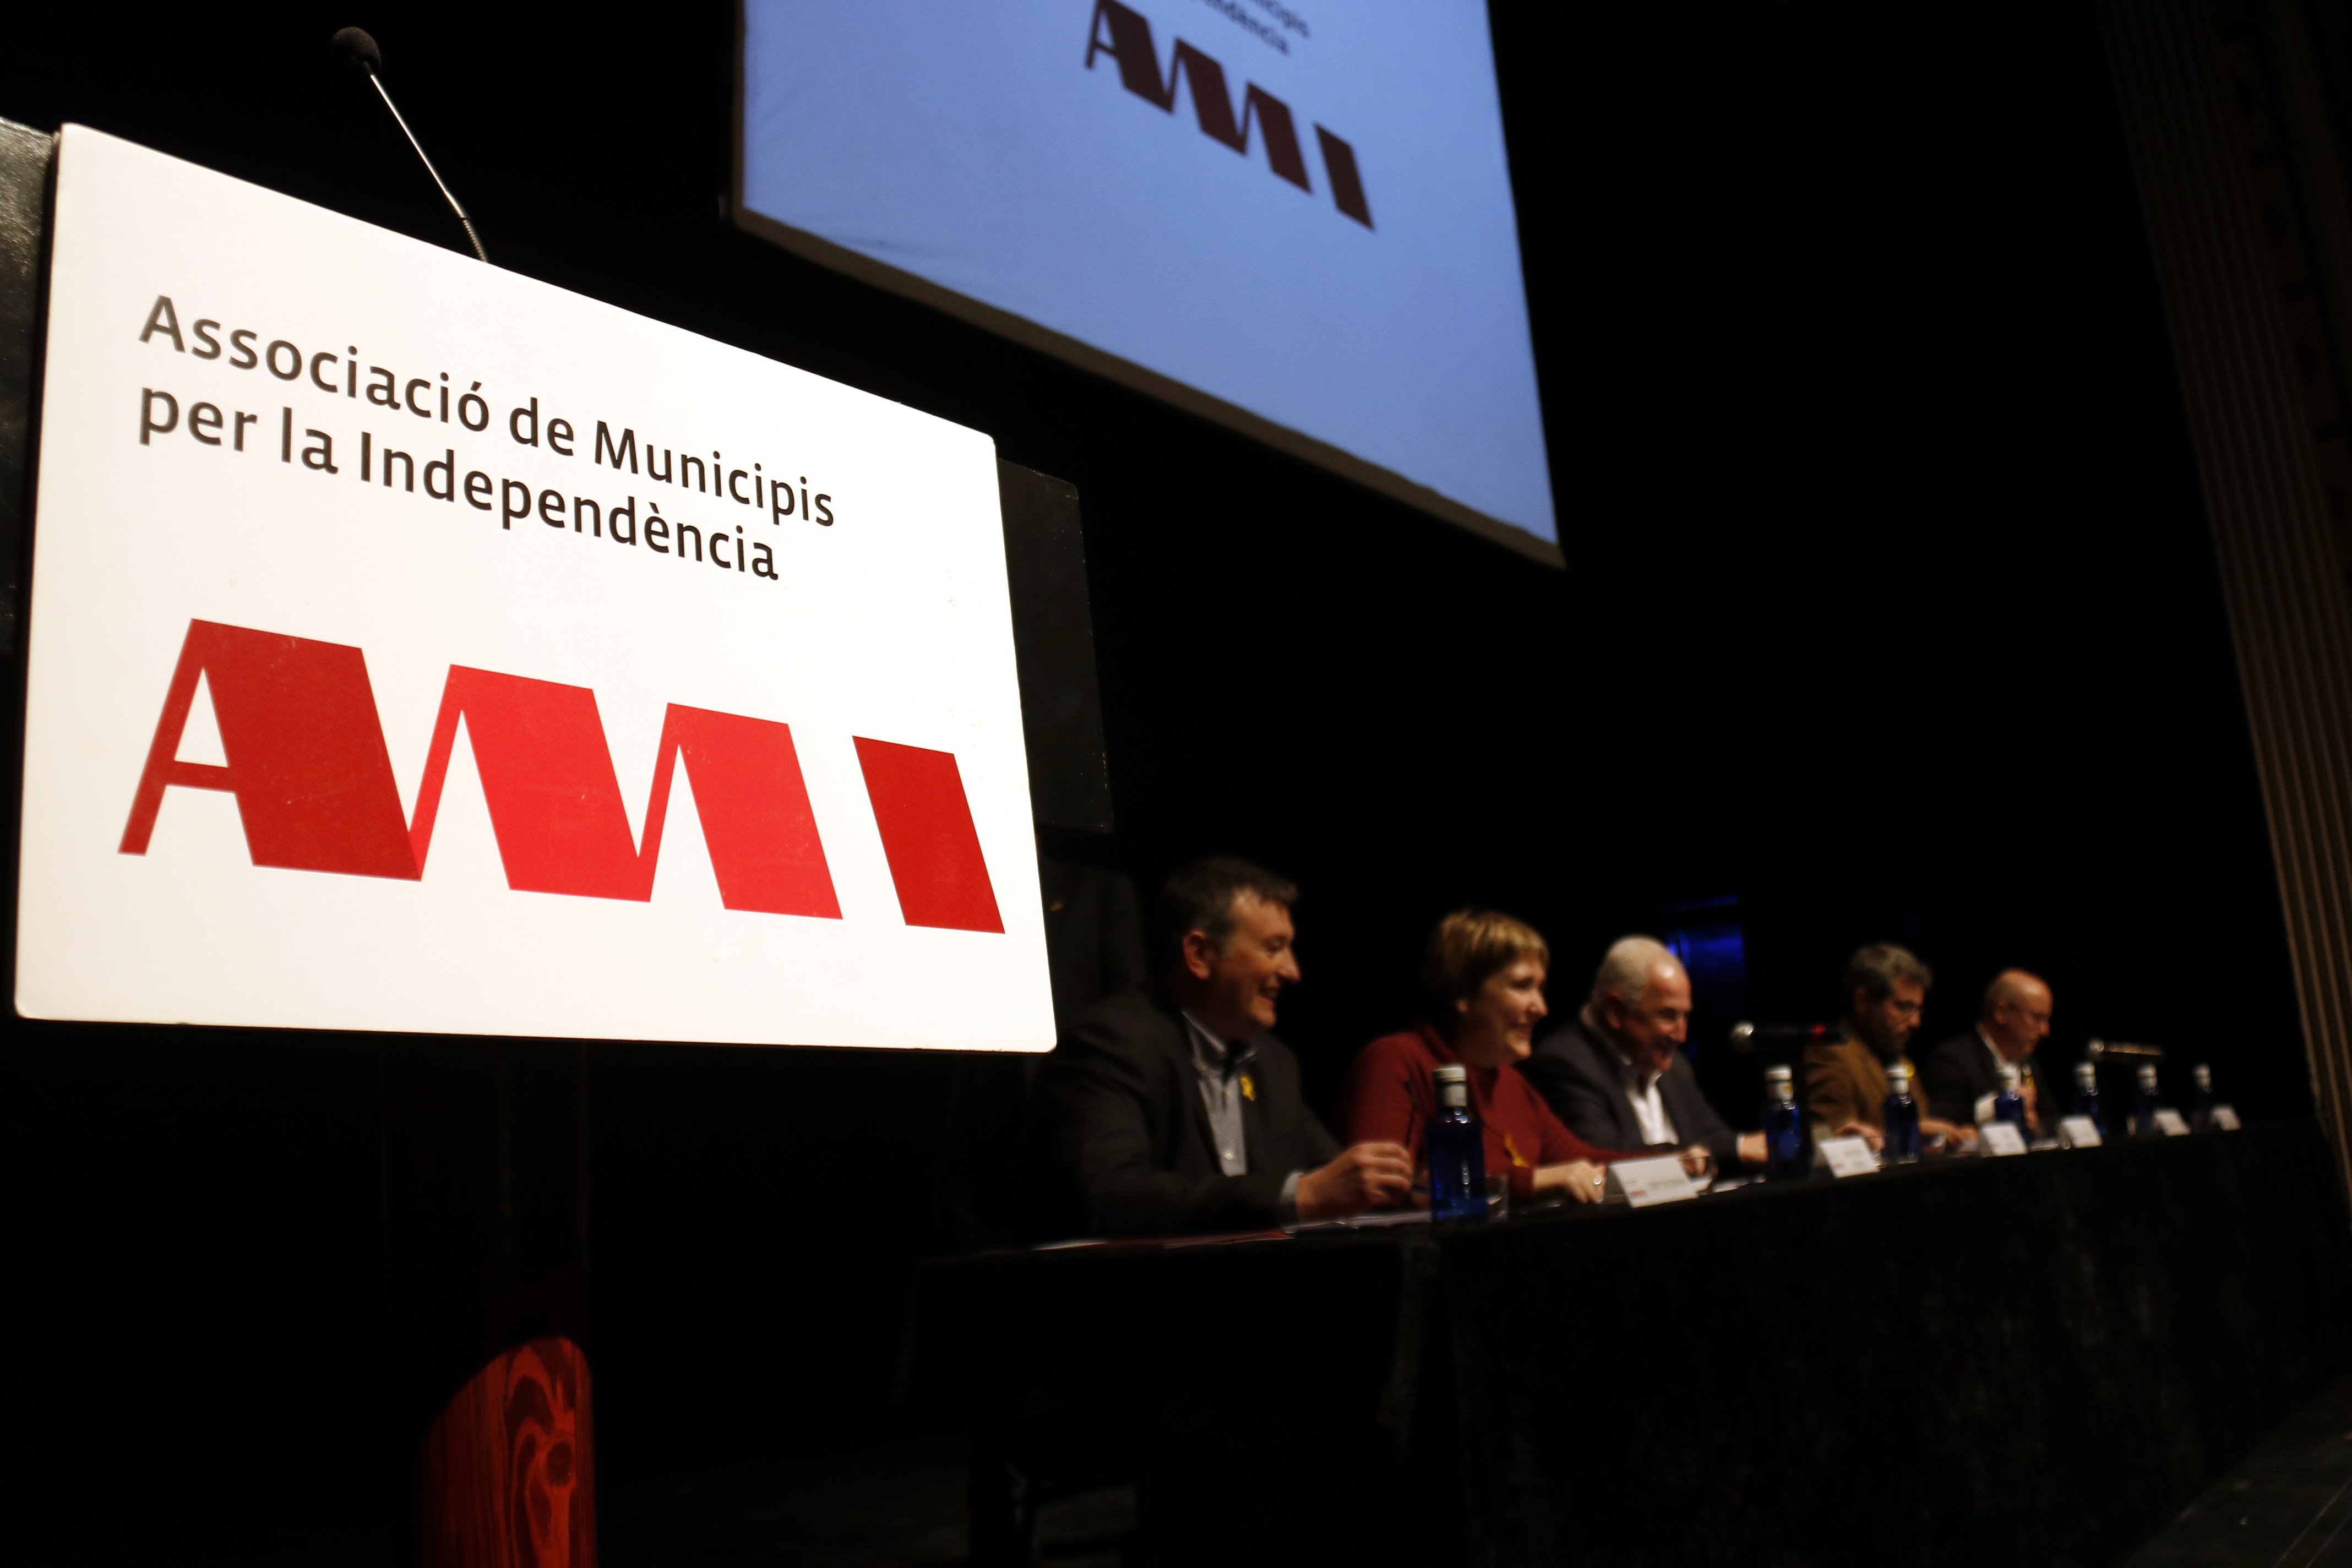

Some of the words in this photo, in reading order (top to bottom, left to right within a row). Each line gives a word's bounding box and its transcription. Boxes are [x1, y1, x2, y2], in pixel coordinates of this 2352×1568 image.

[1085, 0, 1374, 230] AMI
[140, 296, 489, 432] Associació
[510, 397, 574, 456] de
[595, 421, 834, 527] Municipis
[140, 388, 258, 452] per
[281, 407, 339, 475] la
[361, 432, 778, 581] Independència
[119, 619, 1005, 934] AMI
